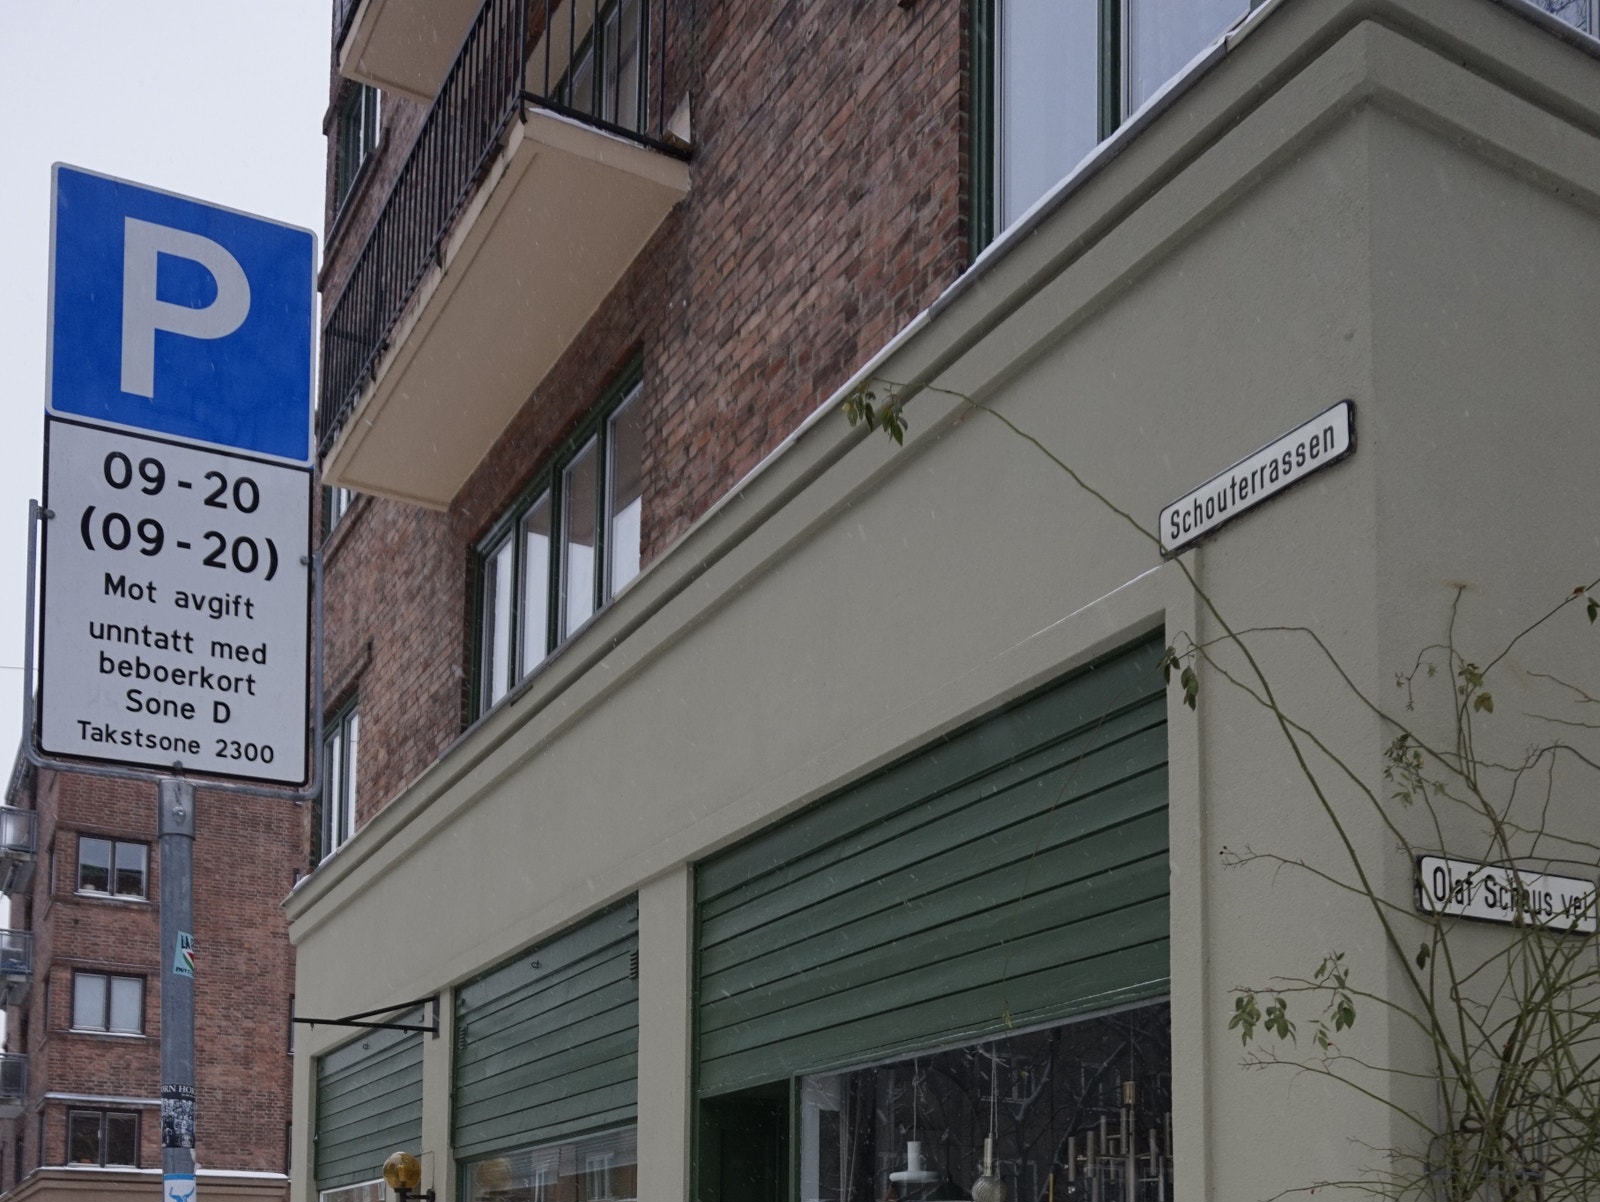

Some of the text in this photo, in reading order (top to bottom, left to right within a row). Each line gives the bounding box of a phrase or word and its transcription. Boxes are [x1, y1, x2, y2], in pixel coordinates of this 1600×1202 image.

[121, 216, 251, 399] P
[1170, 424, 1335, 540] Schouterrassen
[104, 572, 255, 620] Mot avgift
[89, 621, 267, 665] unntatt med
[99, 651, 256, 696] beboerkort
[125, 688, 231, 724] Sone D
[76, 719, 274, 764] Takstsone 2300
[1433, 865, 1473, 907] Olaf
